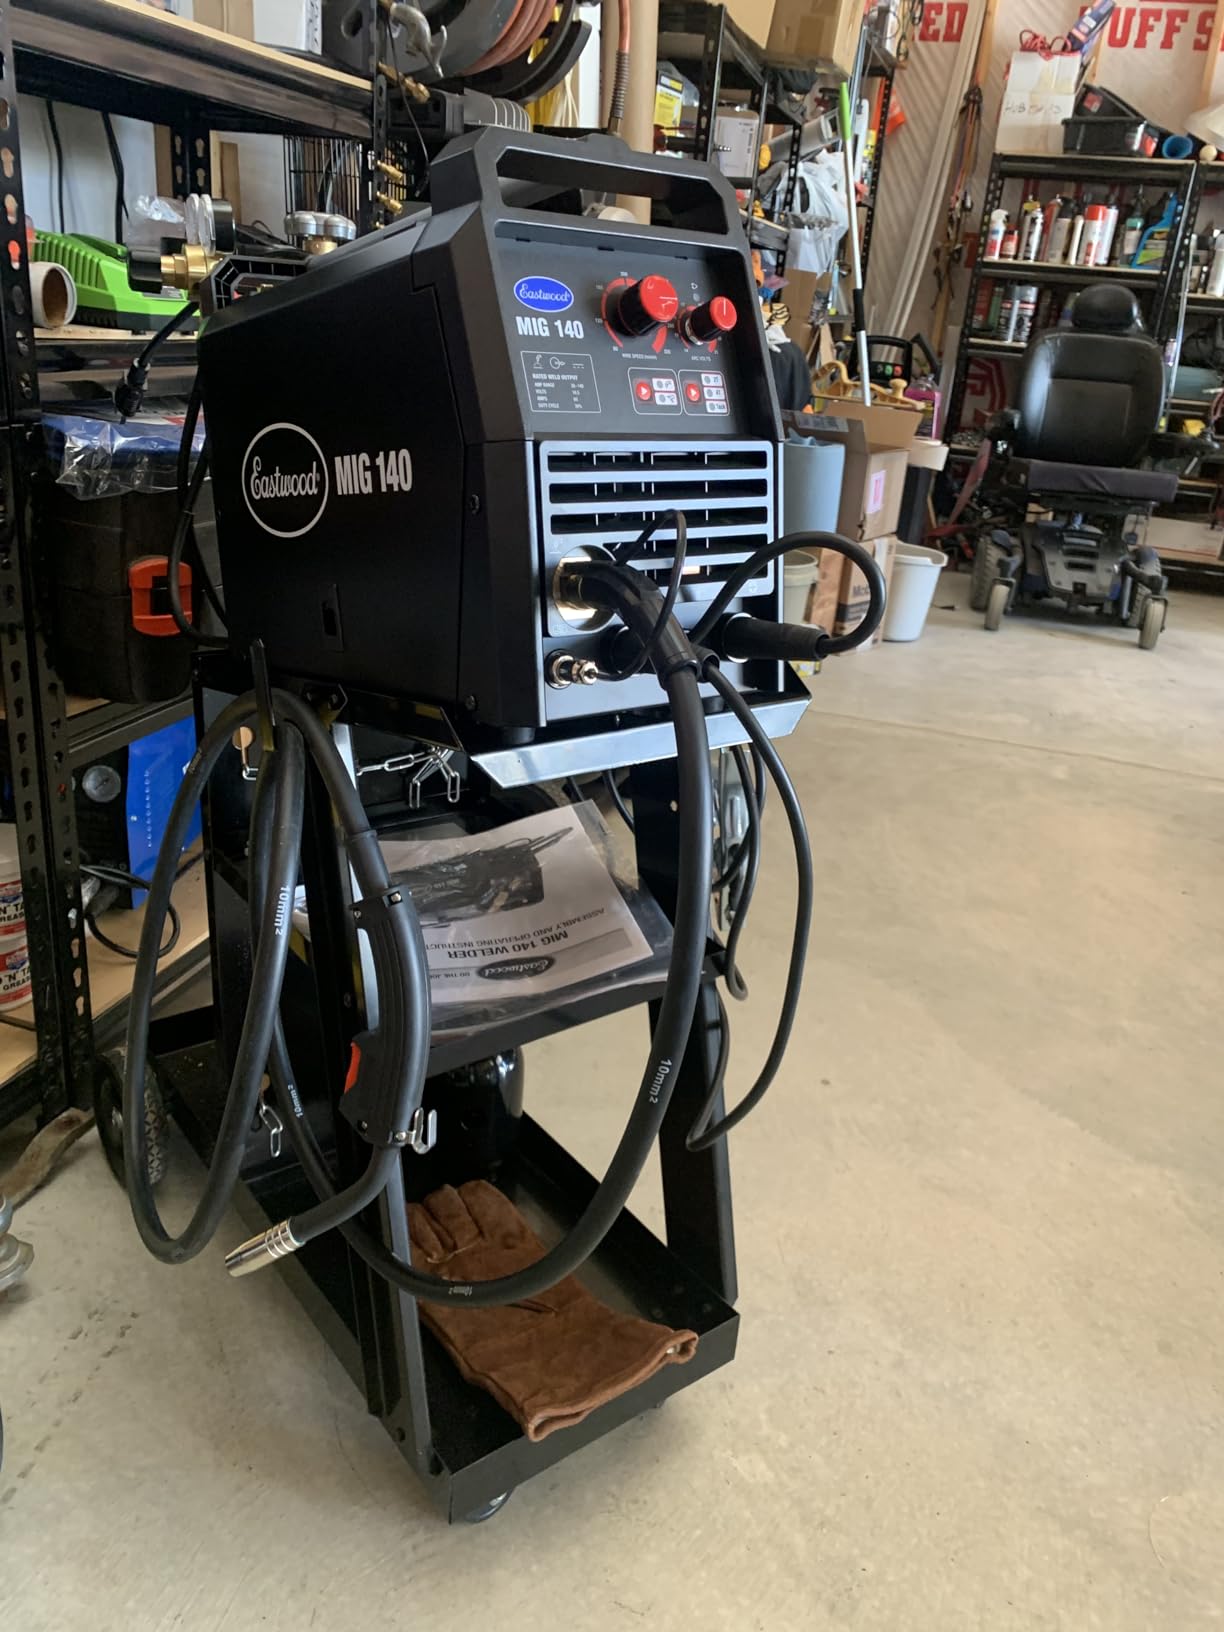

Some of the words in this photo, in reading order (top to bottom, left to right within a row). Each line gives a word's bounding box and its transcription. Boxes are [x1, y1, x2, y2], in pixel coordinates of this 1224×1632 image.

[519, 283, 569, 302] Eastwood
[515, 316, 550, 337] MIG
[554, 319, 584, 339] 140
[251, 456, 318, 500] Eastwood
[334, 452, 373, 495] MIG
[376, 448, 412, 493] 140
[551, 907, 605, 931] ASSEMBLY
[477, 933, 531, 948] OPERATING
[532, 929, 551, 939] AND
[539, 930, 568, 947] MIG
[448, 945, 509, 959] WELDER
[512, 939, 537, 952] 140
[484, 958, 549, 977] Eastwood
